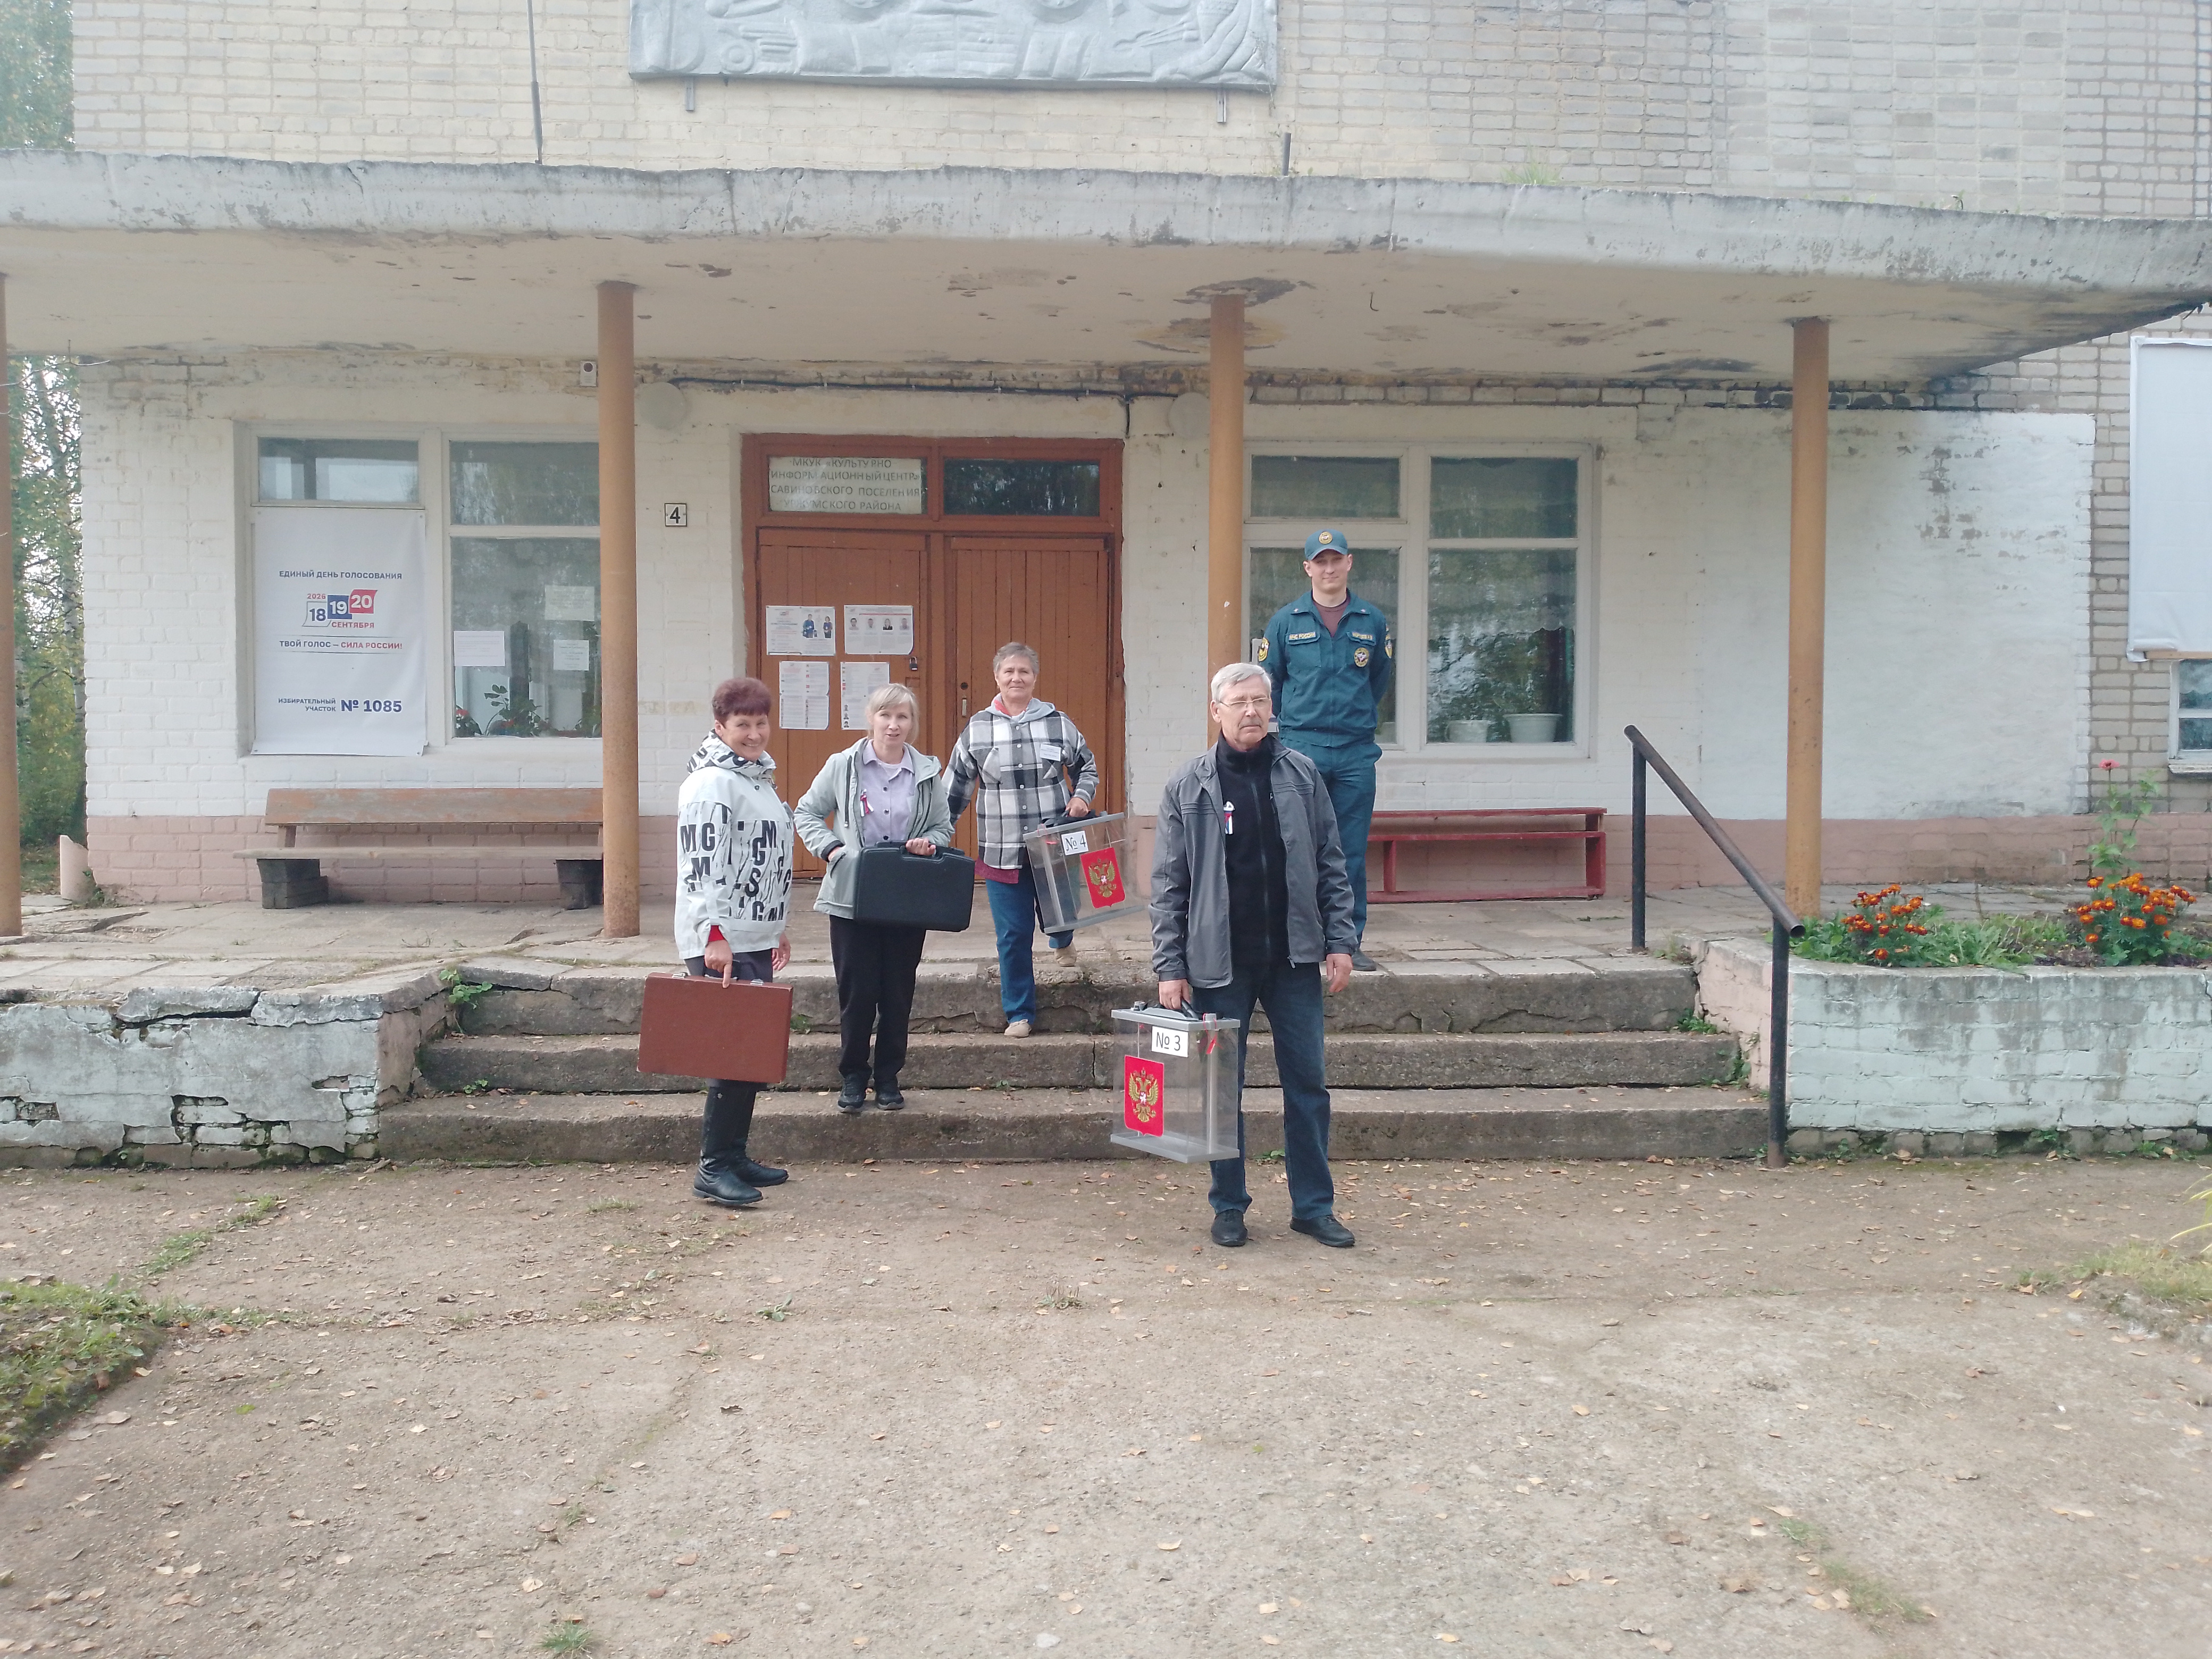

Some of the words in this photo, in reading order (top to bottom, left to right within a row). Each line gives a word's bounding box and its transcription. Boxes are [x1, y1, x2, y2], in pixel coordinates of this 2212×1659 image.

[771, 484, 853, 495] САВИНОВСКОГО
[859, 487, 920, 496] ПОСЕЛЕНИЯ
[860, 501, 901, 510] РАЙОНА
[669, 506, 681, 524] 4
[279, 569, 314, 578] ЕДИНЫЙ
[330, 600, 347, 614] 19
[351, 594, 372, 608] 20
[309, 608, 326, 622] 18
[341, 699, 359, 712] №
[363, 700, 402, 713] 1085
[1080, 834, 1086, 848] 4
[1174, 1035, 1180, 1051] 3
